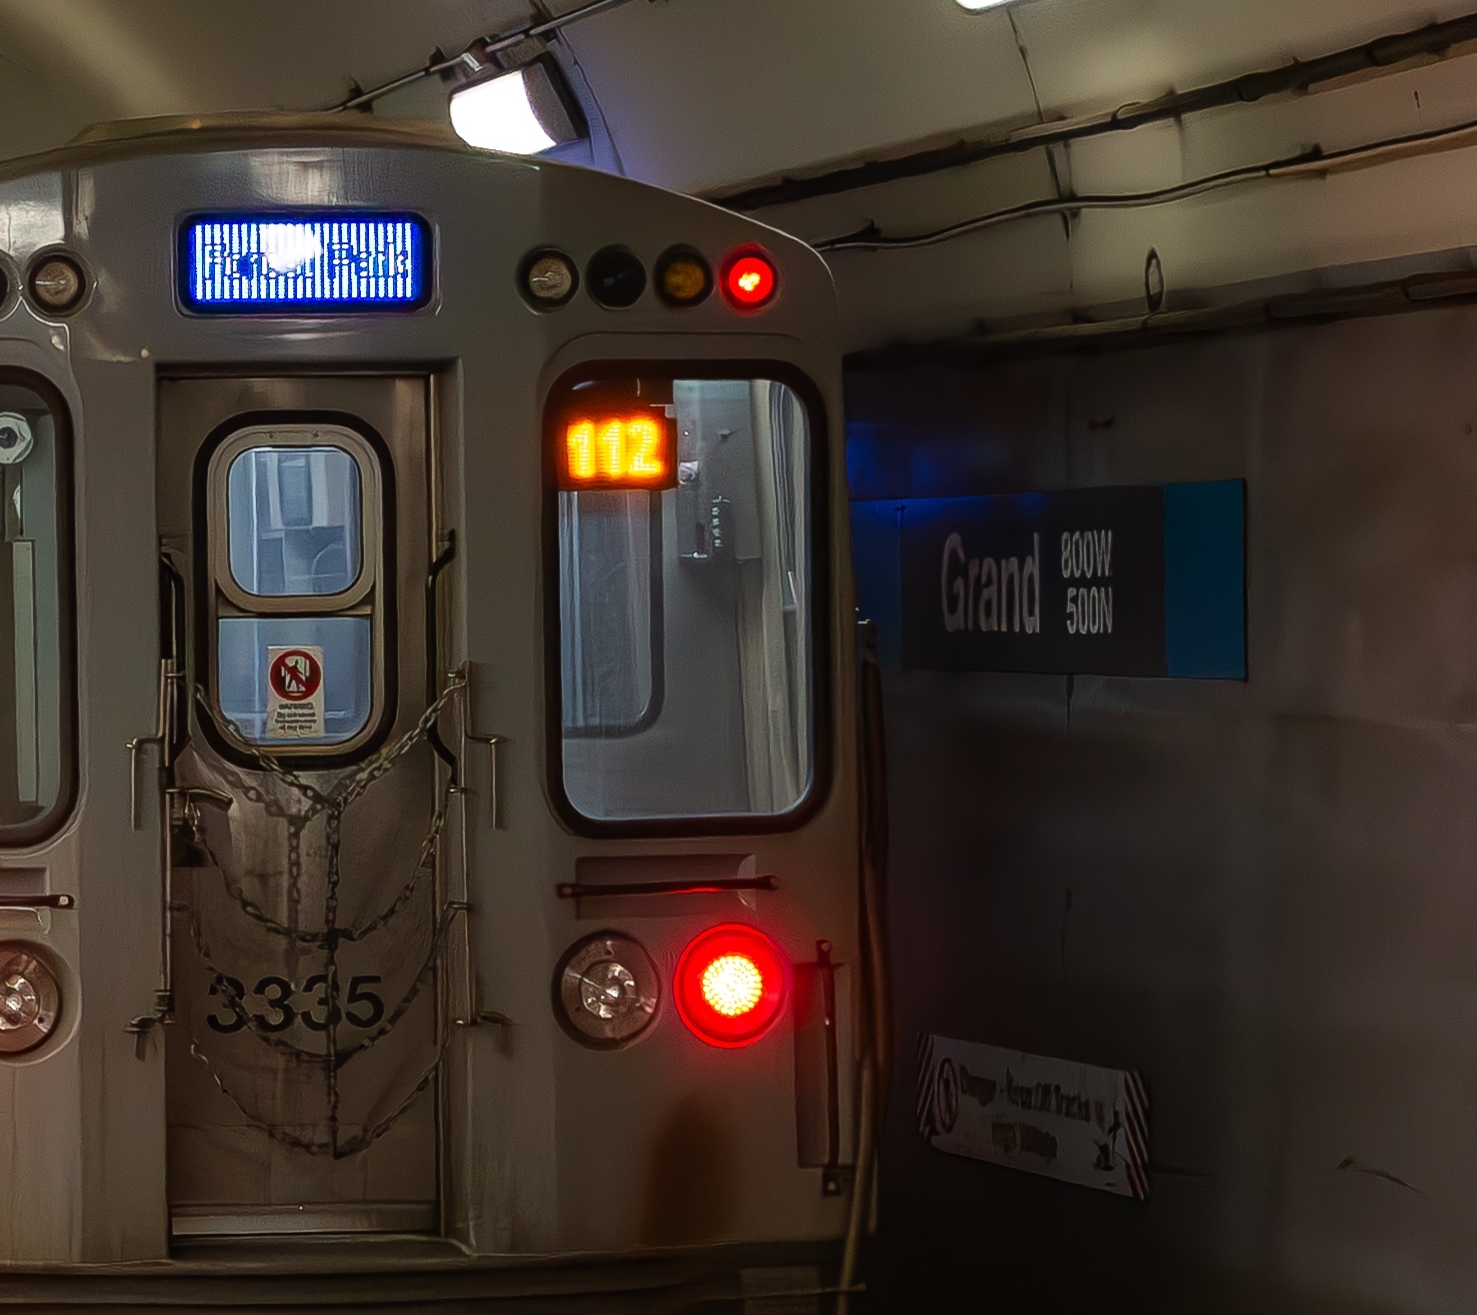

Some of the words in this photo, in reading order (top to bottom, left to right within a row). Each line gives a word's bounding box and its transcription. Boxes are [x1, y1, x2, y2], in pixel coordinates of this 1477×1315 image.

[328, 242, 411, 279] Park
[568, 420, 663, 477] 112
[1061, 530, 1113, 579] 800W
[942, 532, 1040, 634] Grand
[1066, 586, 1113, 635] 500N
[206, 973, 385, 1034] 3335
